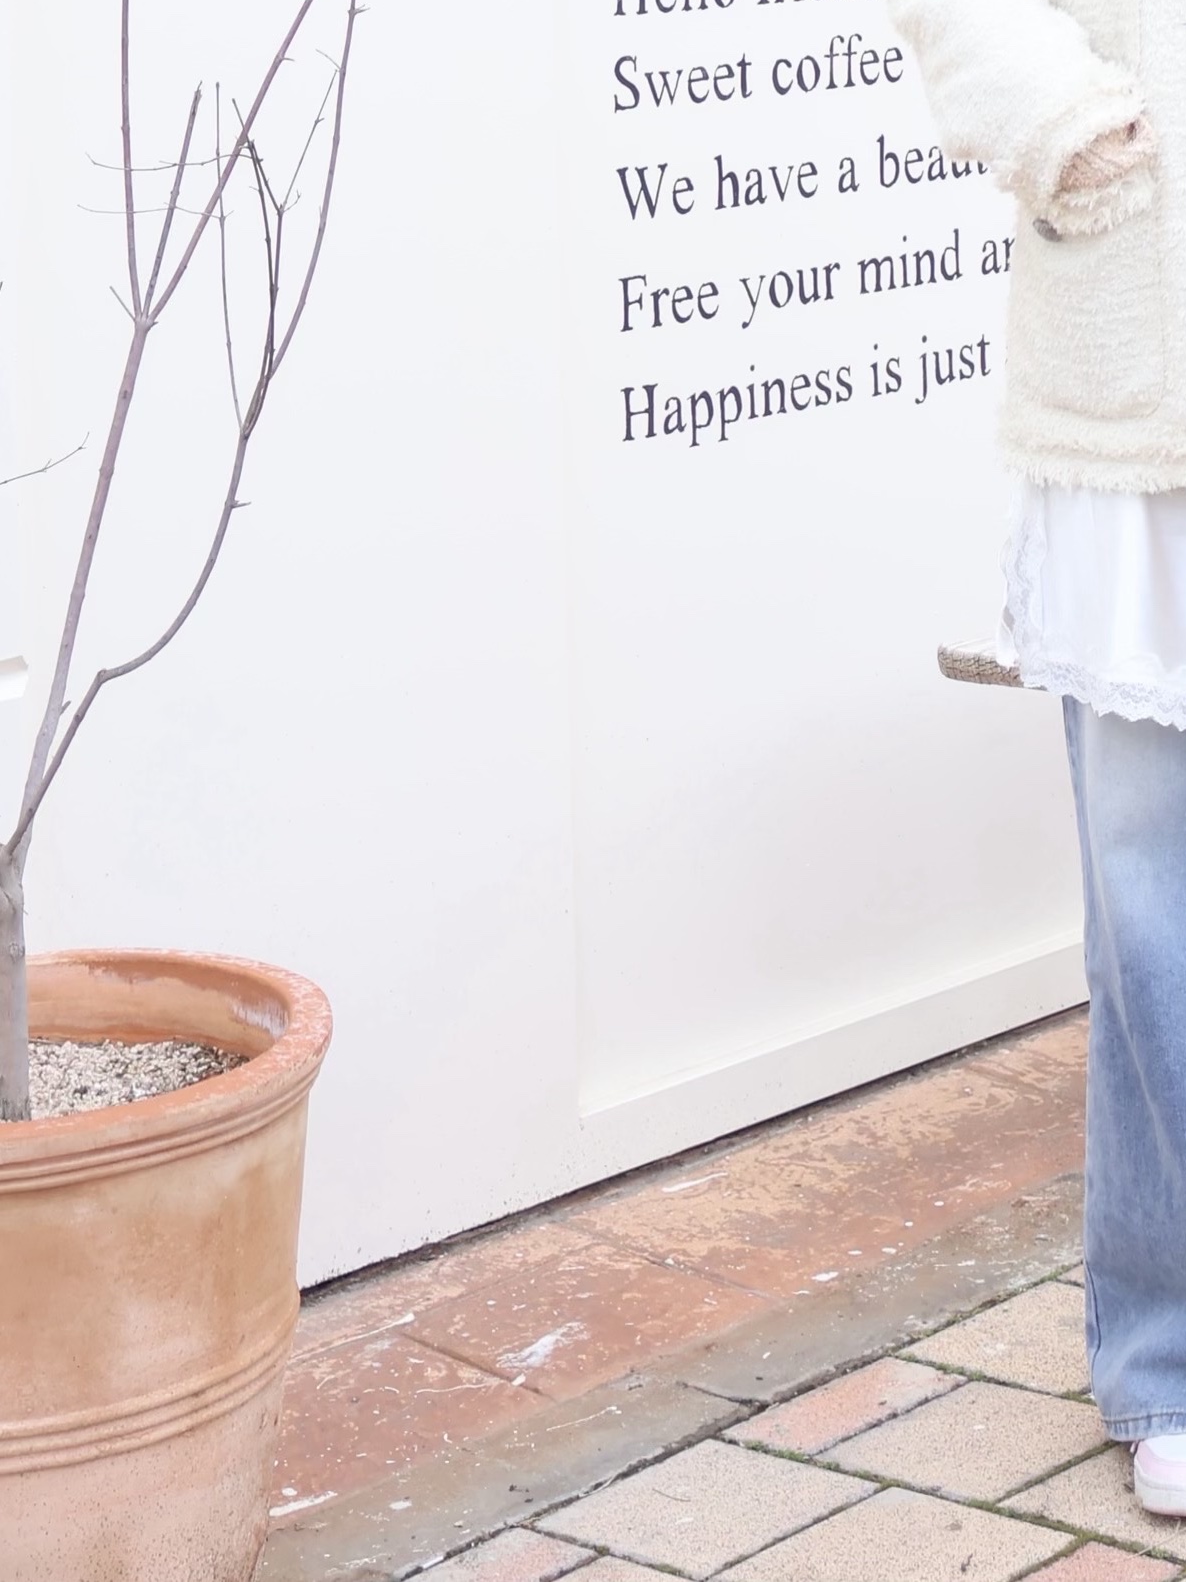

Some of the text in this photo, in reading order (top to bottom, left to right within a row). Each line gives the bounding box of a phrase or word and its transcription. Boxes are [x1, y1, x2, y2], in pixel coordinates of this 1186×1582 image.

[613, 33, 904, 114] Sweet coffee
[615, 162, 695, 221] We
[713, 154, 819, 211] have
[837, 156, 861, 194] a
[618, 274, 720, 333] Free
[738, 262, 841, 330] your
[856, 228, 963, 295] mind
[620, 333, 992, 448] Happiness is just
